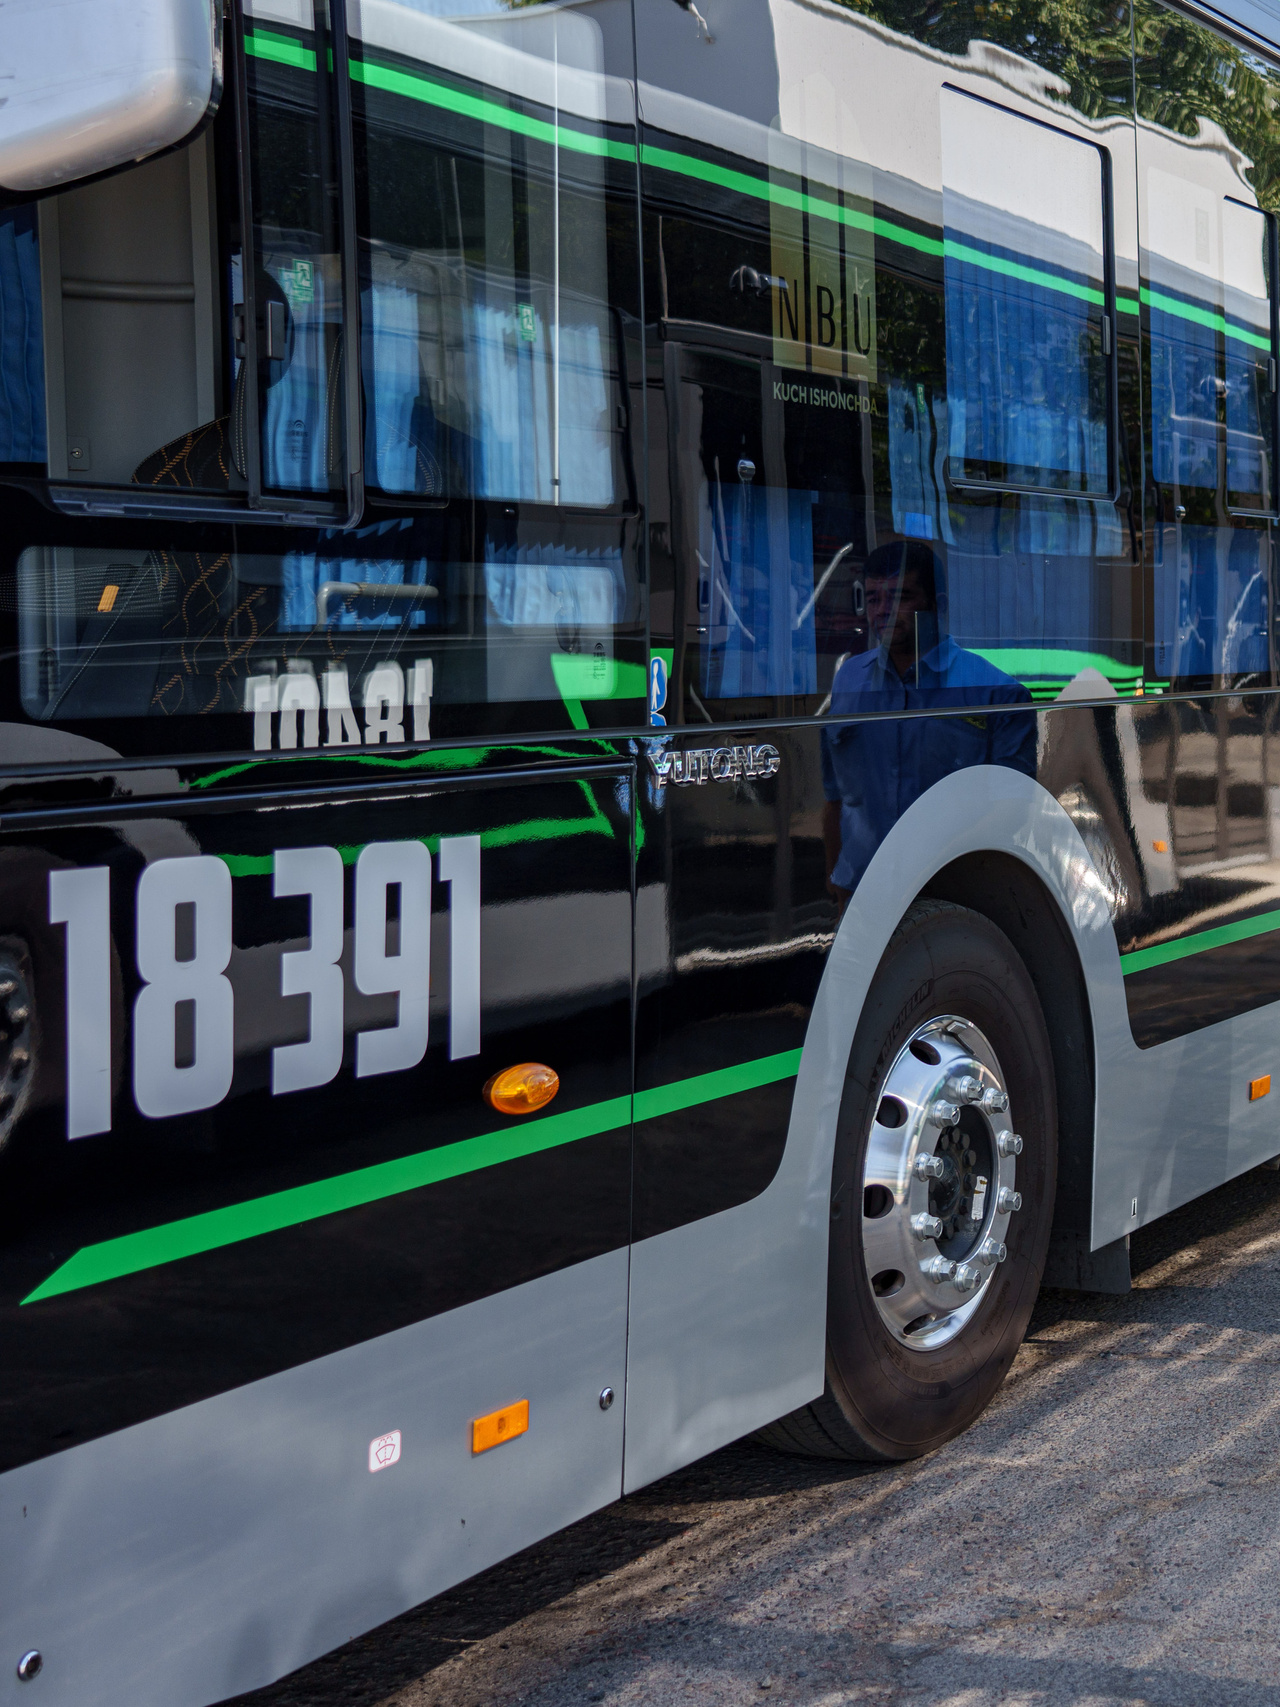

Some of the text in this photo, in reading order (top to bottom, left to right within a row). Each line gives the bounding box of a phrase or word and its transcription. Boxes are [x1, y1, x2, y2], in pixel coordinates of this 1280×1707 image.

[779, 276, 871, 356] NBU
[773, 381, 878, 415] KUCH ISHONCHDA
[648, 744, 780, 788] YUTONG
